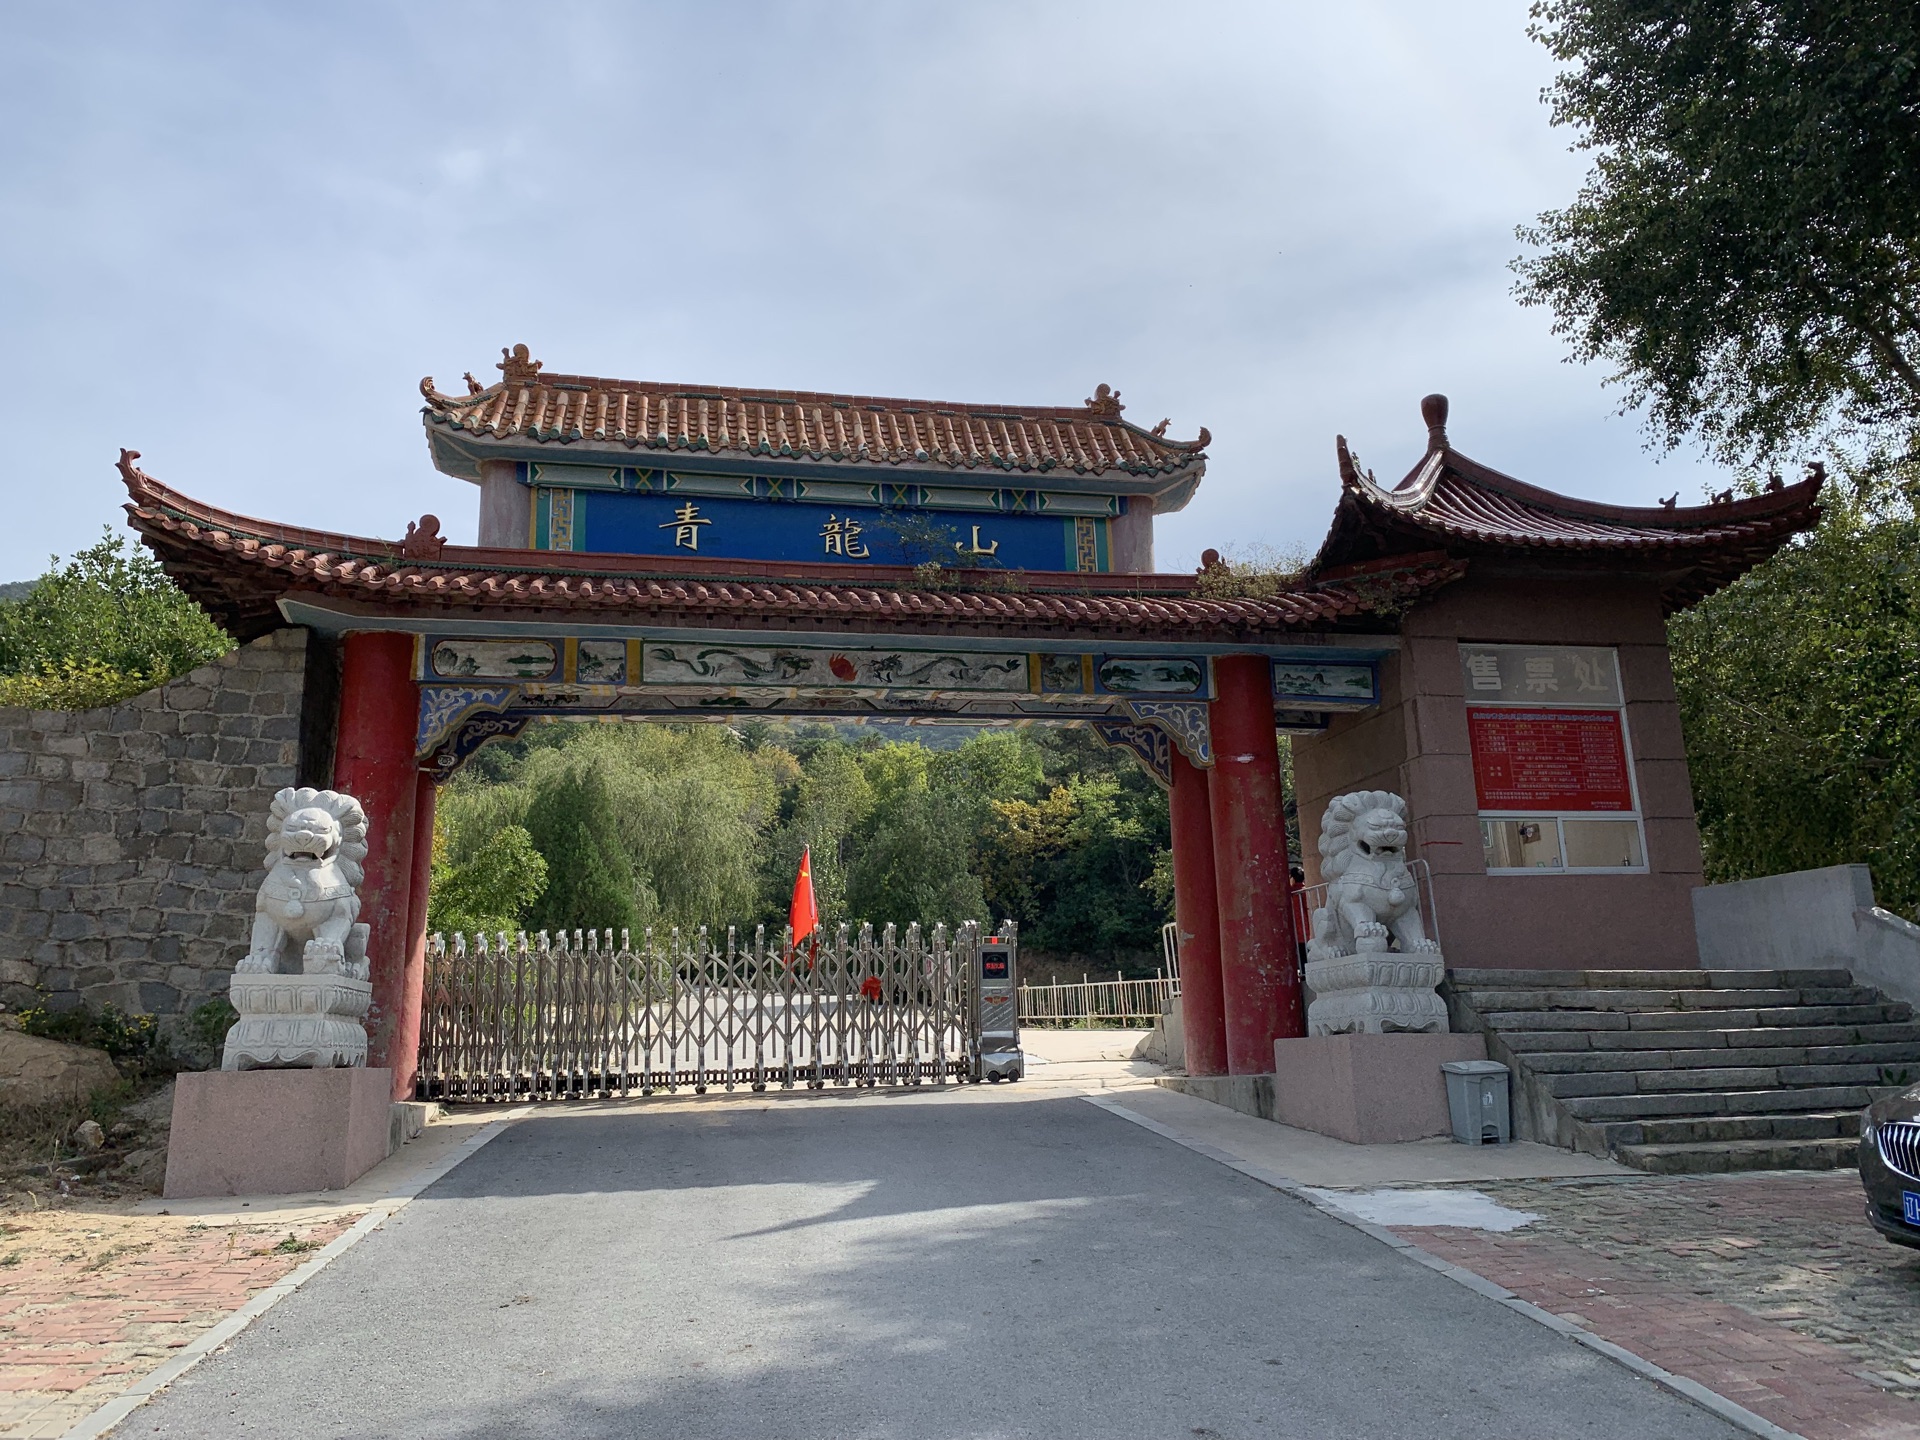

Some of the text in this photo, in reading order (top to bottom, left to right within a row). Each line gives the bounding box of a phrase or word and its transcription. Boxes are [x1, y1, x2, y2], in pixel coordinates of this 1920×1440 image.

[659, 502, 998, 559] 青龍山
[1466, 654, 1608, 693] 售票处
